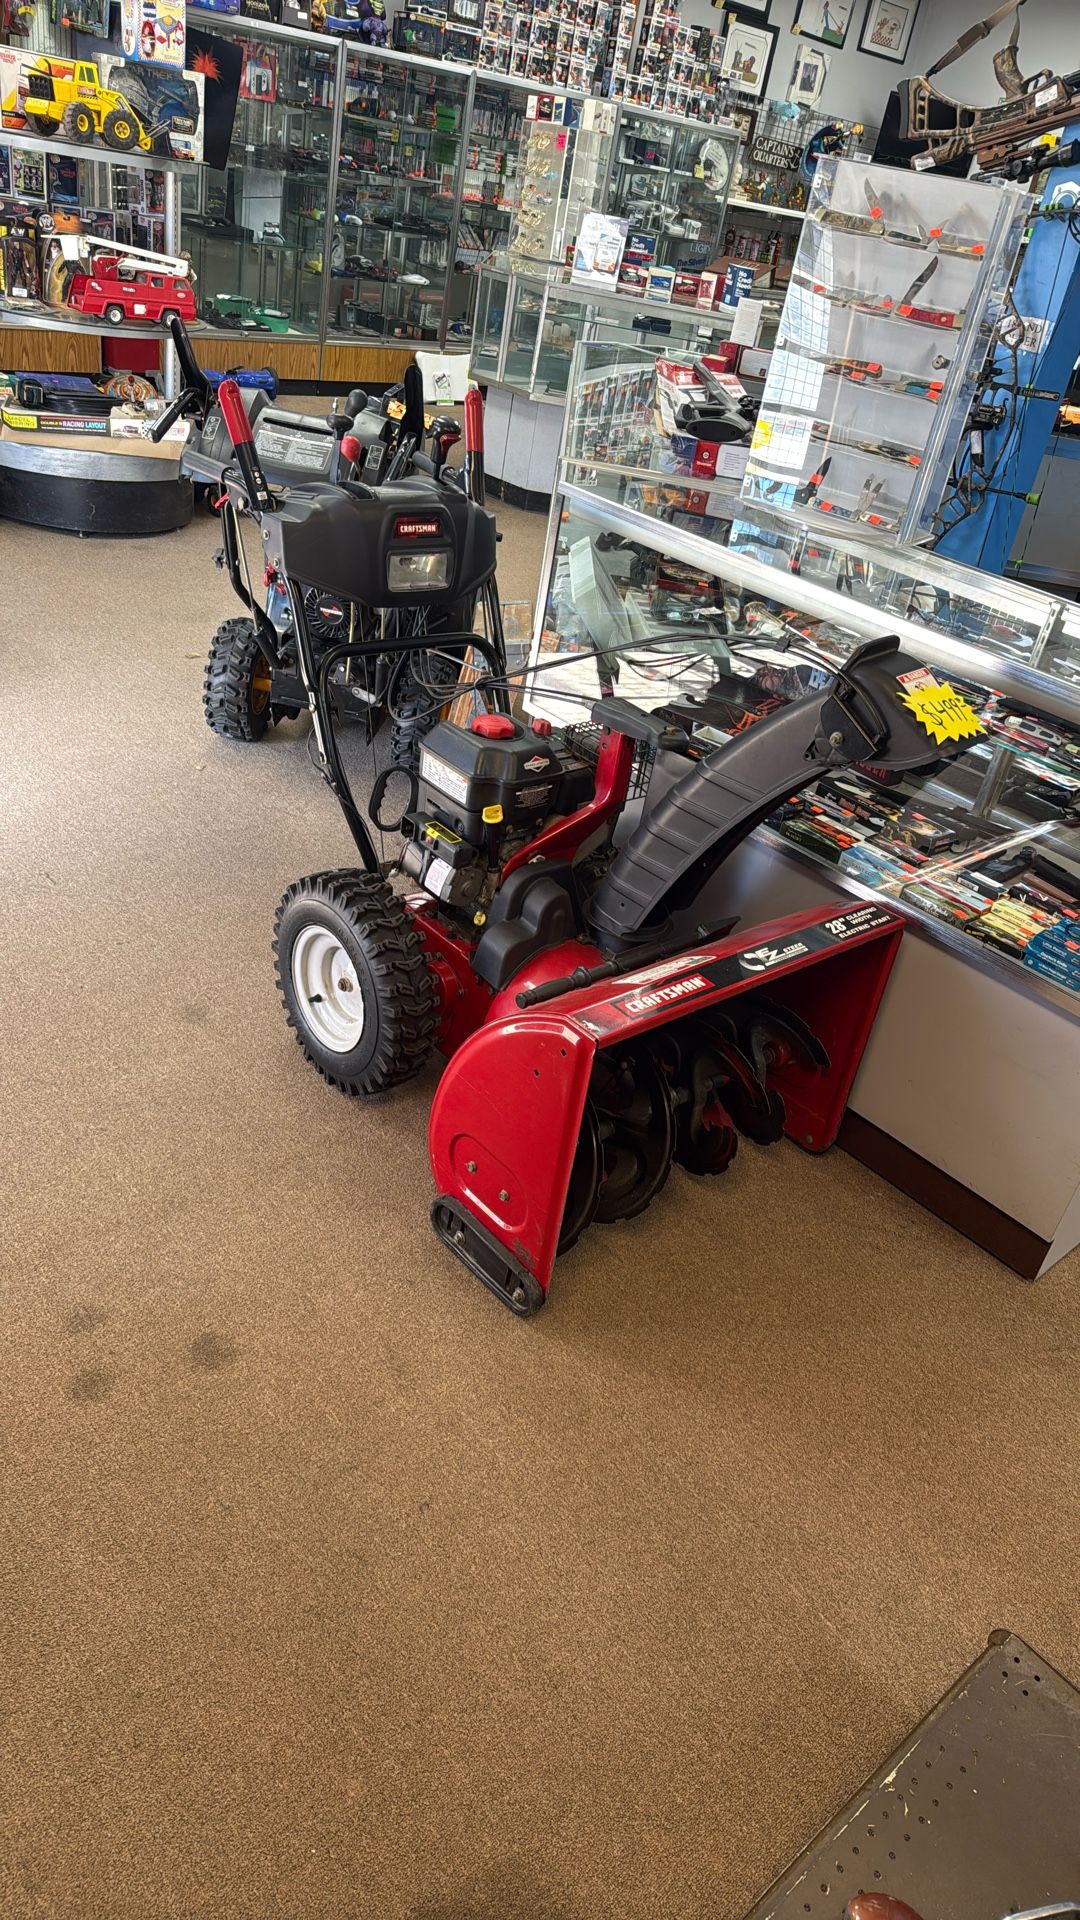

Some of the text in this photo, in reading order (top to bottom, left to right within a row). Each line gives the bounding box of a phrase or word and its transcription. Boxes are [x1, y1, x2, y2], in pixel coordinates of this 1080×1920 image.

[755, 137, 795, 157] CAPTAIN'S
[753, 150, 789, 169] QUARTERS
[63, 420, 85, 428] RACING
[85, 421, 107, 429] LAYOUT
[400, 524, 436, 533] CRAFTSMAN
[845, 906, 877, 921] CLEARING
[850, 914, 873, 925] WIDTH
[838, 915, 891, 939] ELECTRIC START
[755, 947, 779, 961] EZ
[782, 942, 804, 953] STEER
[625, 977, 706, 1012] CRAFTSMAN
